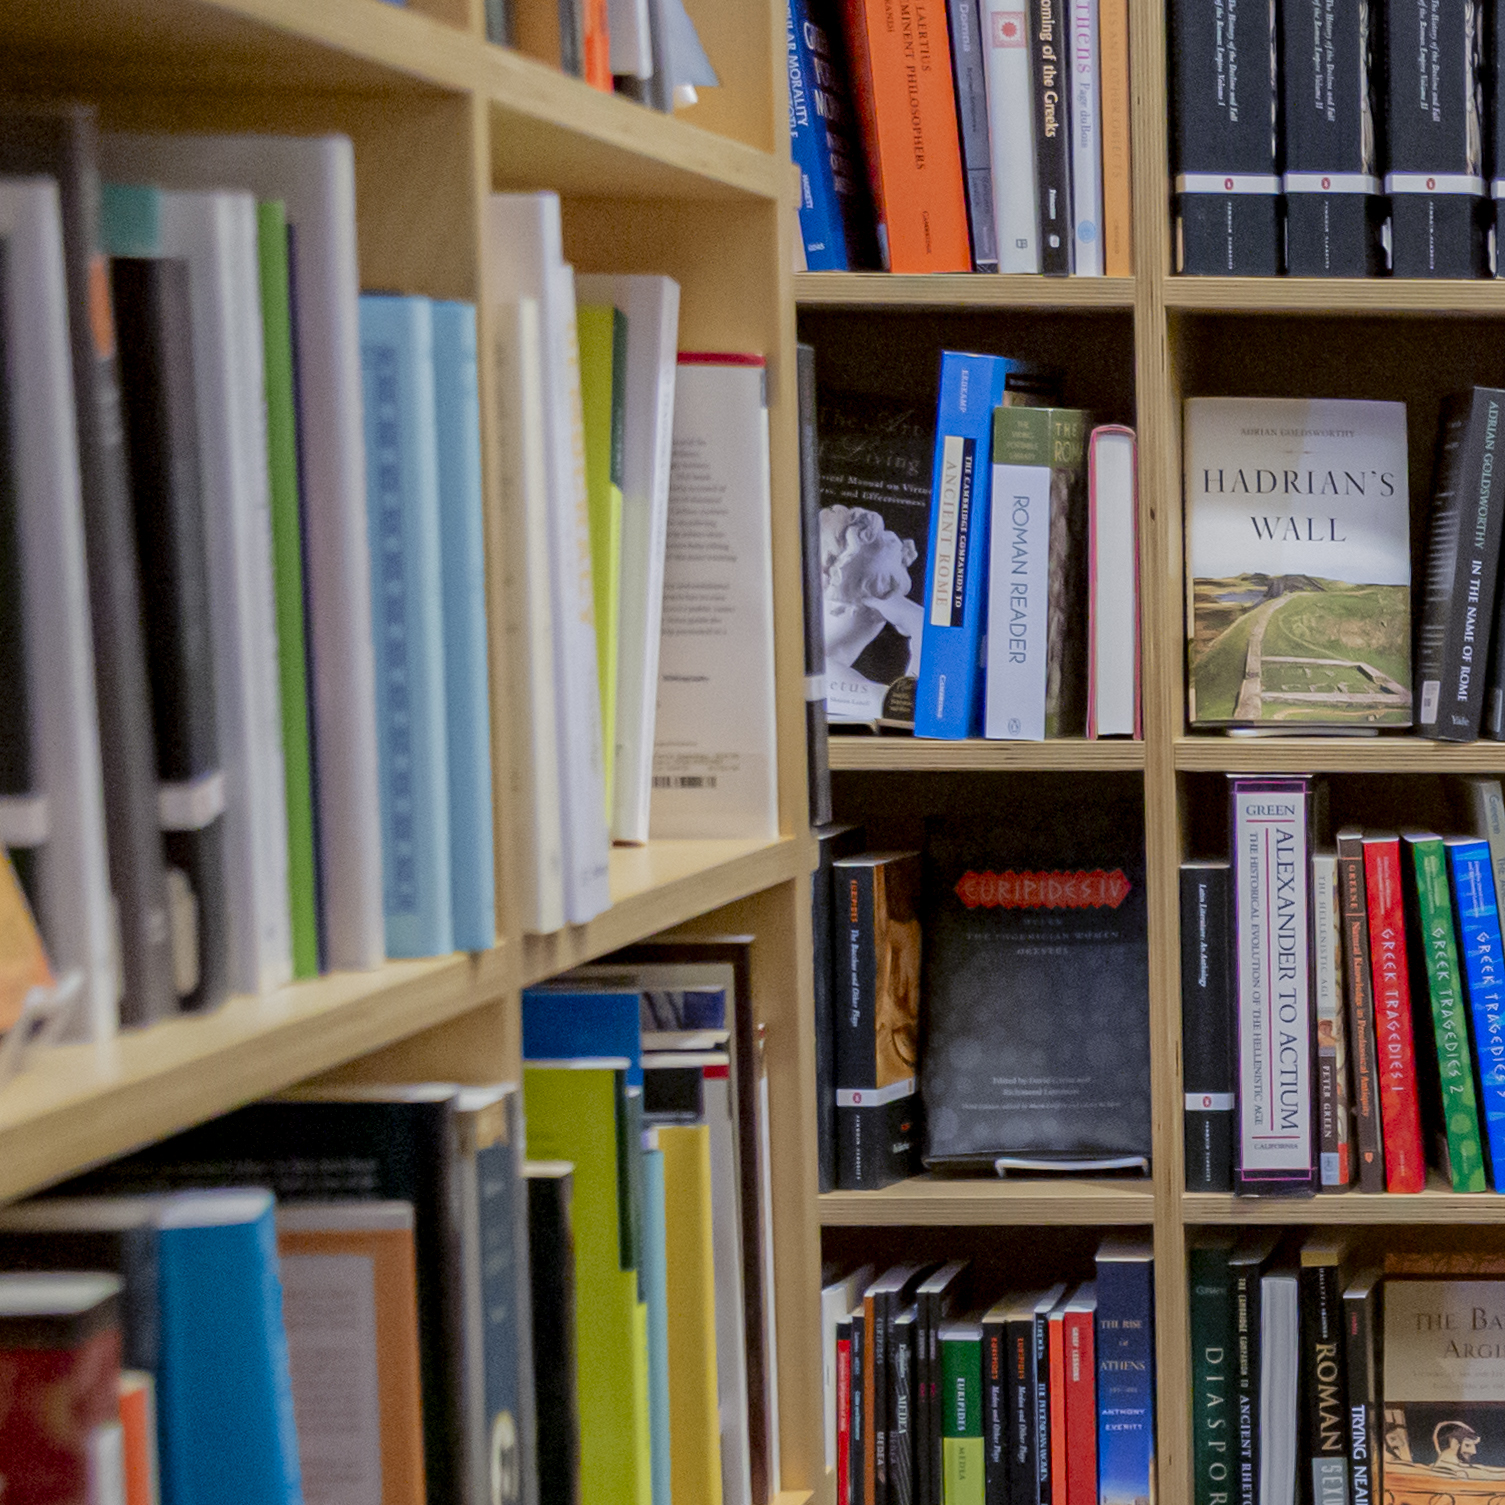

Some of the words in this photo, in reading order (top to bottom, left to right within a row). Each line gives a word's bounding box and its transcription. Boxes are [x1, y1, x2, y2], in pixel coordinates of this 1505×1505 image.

[1042, 46, 1056, 60] of
[1044, 65, 1057, 86] the
[787, 65, 808, 126] MORALITY
[1044, 91, 1058, 137] Greeks
[1484, 401, 1499, 450] ADRIAN
[1203, 468, 1395, 496] HADRIAN'S
[940, 461, 958, 545] ANCIENT
[1474, 453, 1496, 549] GOLDSWORTHY
[1010, 495, 1030, 575] ROMAN
[1251, 516, 1346, 542] WALL
[935, 554, 952, 607] ROME
[1471, 560, 1482, 575] IN
[1468, 579, 1481, 603] THE
[1008, 582, 1029, 664] READER
[1463, 606, 1479, 642] NAME
[1462, 646, 1474, 662] OF
[1457, 666, 1470, 702] ROME
[1245, 805, 1296, 815] GREEN
[1250, 833, 1259, 854] THE
[965, 877, 1091, 899] EURIPIDES
[1101, 877, 1122, 899] IV
[1251, 856, 1261, 921] HISTORICAL
[1275, 828, 1297, 981] ALEXANDER
[1251, 923, 1262, 988] EVOLUTION
[1431, 927, 1448, 981] GREEK
[1476, 932, 1496, 985] GREEK
[1252, 991, 1262, 1006] OF
[1279, 987, 1298, 1023] TO
[1252, 1008, 1263, 1030] THE
[1438, 990, 1460, 1077] TRAGEDIES
[1253, 1033, 1263, 1101] HELLENISTIC
[1279, 1031, 1300, 1129] ACTIUM
[1322, 1066, 1332, 1100] PETER
[1450, 1085, 1464, 1095] 2
[1253, 1104, 1264, 1125] AGE
[1322, 1103, 1333, 1138] GREEN
[1416, 1311, 1456, 1331] THE
[1100, 1361, 1146, 1371] ATHENS
[957, 1377, 966, 1431] EURIPIDES
[1315, 1342, 1342, 1451] ROMAN
[1351, 1405, 1368, 1460] TRYING
